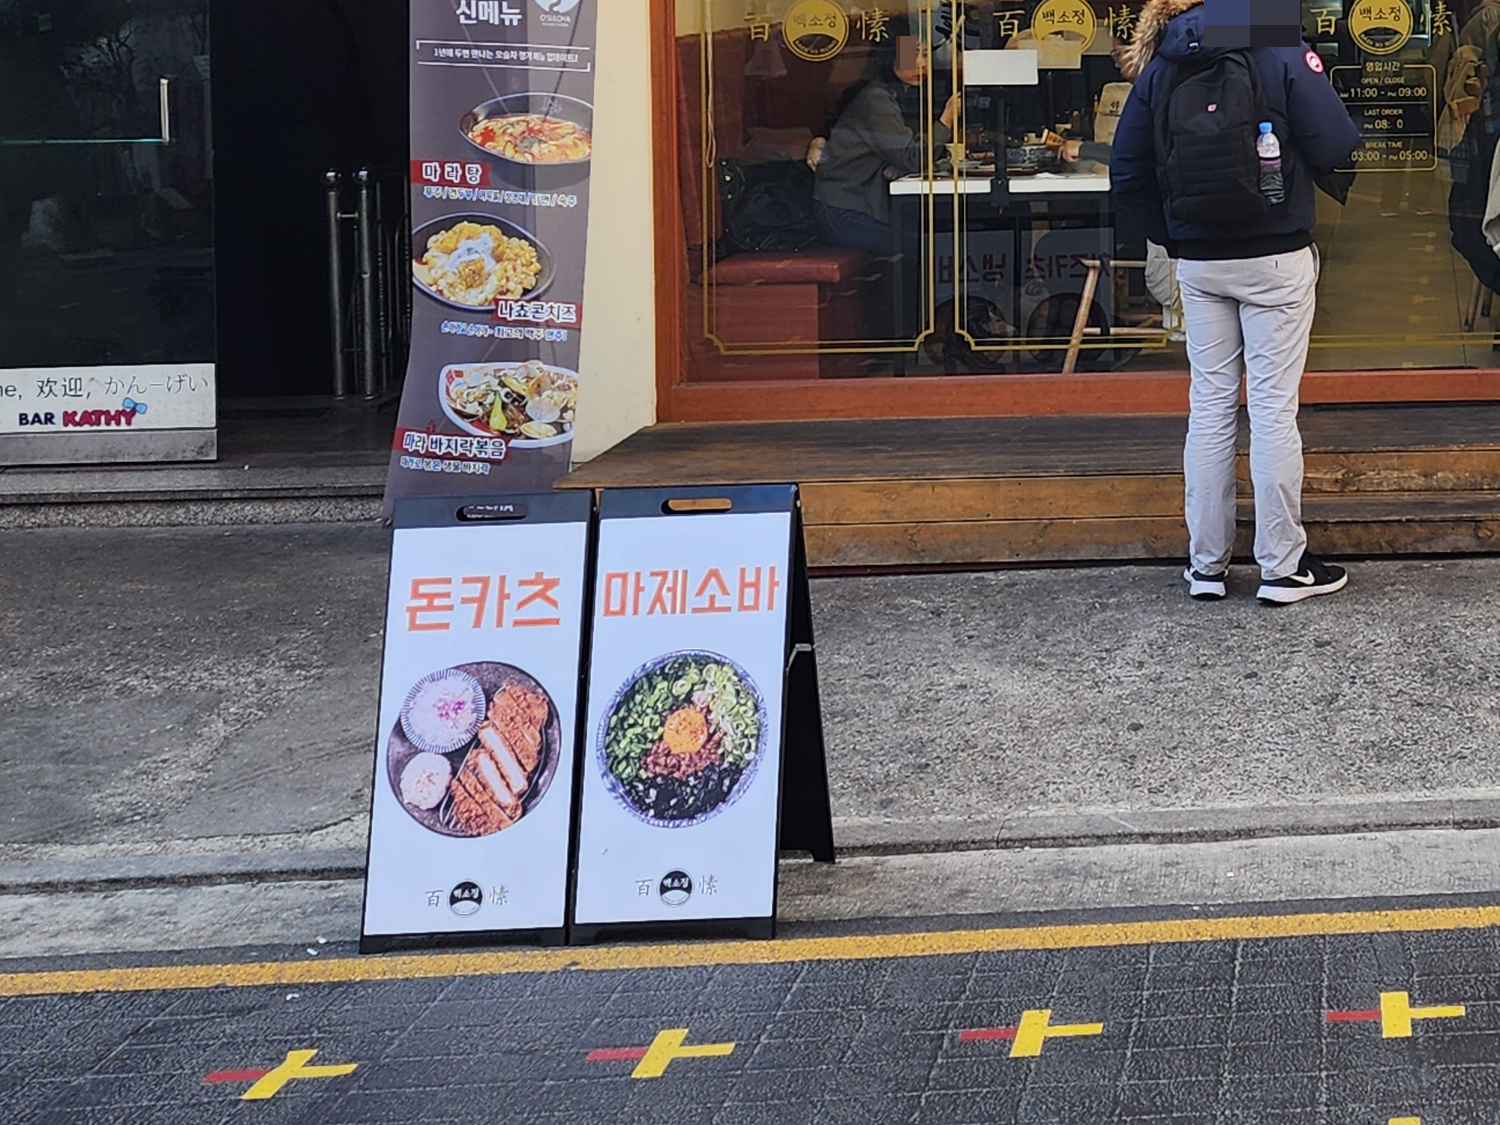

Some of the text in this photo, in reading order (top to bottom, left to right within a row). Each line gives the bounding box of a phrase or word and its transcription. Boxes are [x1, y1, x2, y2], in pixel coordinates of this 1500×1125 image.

[456, 0, 522, 26] 신메뉴
[992, 9, 1025, 38] 百
[1041, 8, 1085, 26] 백소정
[1310, 6, 1342, 36] 百
[1358, 5, 1402, 22] 백소정
[1365, 61, 1400, 72] 영업시간
[1350, 88, 1378, 98] 11:00
[1398, 87, 1427, 97] 09:00
[1382, 108, 1403, 116] ORDER
[1351, 151, 1379, 161] 03:00
[1399, 150, 1427, 161] 05:00
[498, 300, 577, 324] 나쵸콘치즈
[19, 408, 136, 427] BAR KATHY
[403, 431, 427, 453] 마라
[406, 572, 561, 632] 돈카츠
[603, 565, 780, 618] 마제소바
